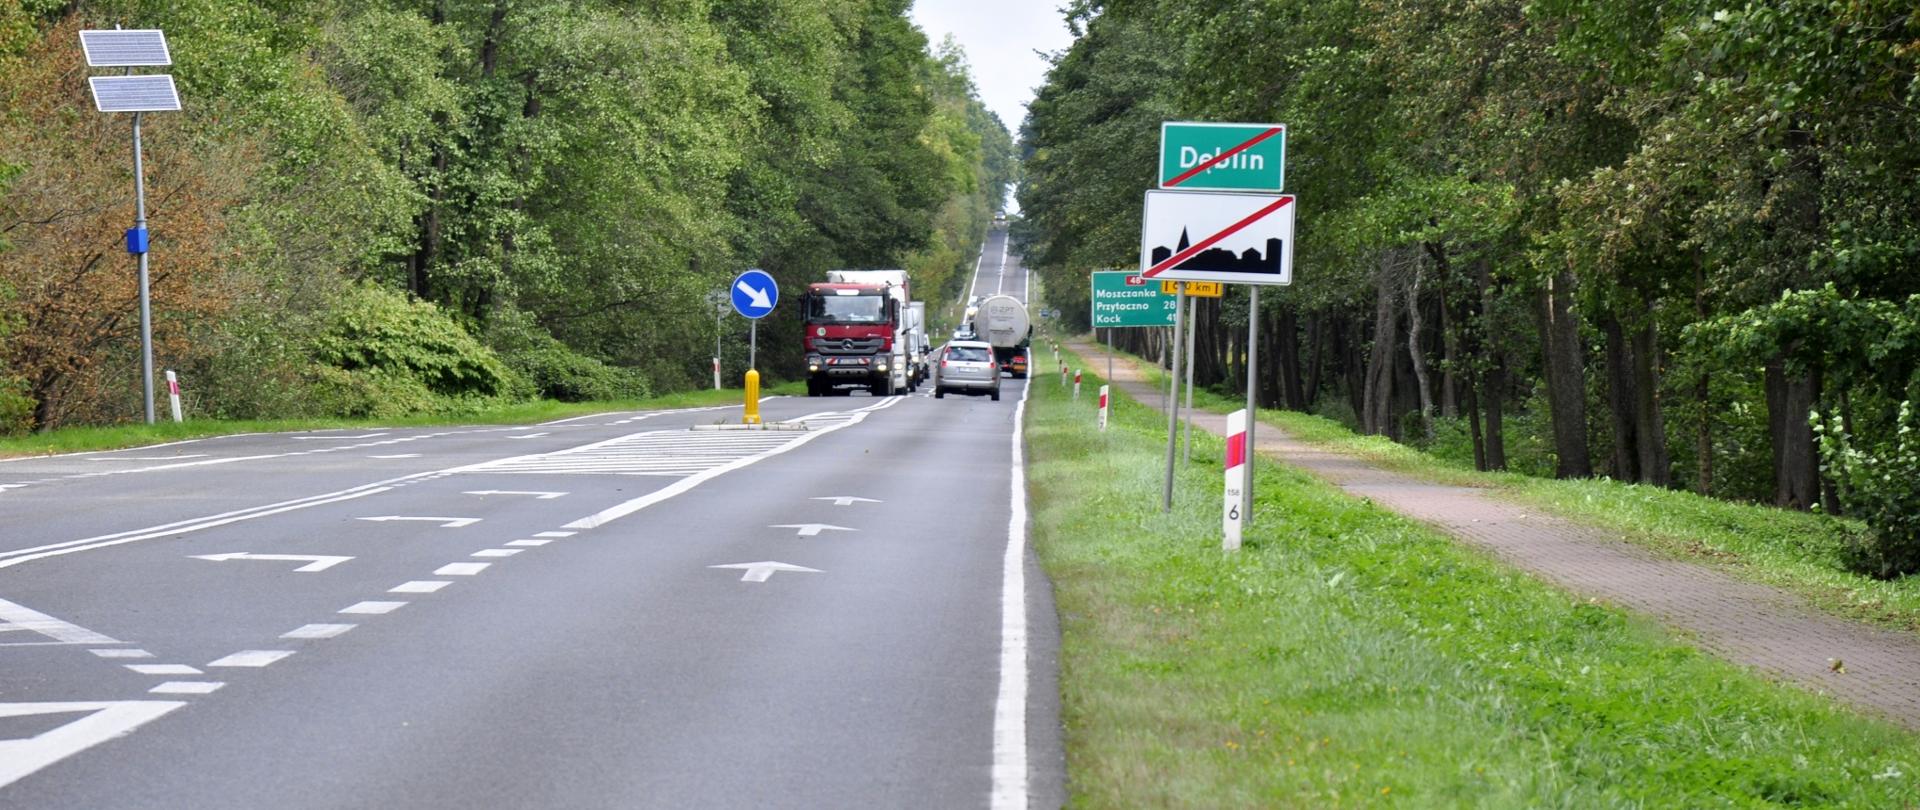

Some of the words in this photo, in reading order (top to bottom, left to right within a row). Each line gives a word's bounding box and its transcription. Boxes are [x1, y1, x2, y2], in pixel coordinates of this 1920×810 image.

[1180, 146, 1264, 174] Dęblin
[1195, 282, 1211, 292] km
[1097, 289, 1157, 299] Moszczanka
[1096, 302, 1150, 312] Przytoczno
[1163, 301, 1176, 310] 28
[1096, 314, 1122, 324] Kock
[1229, 504, 1239, 520] 6
